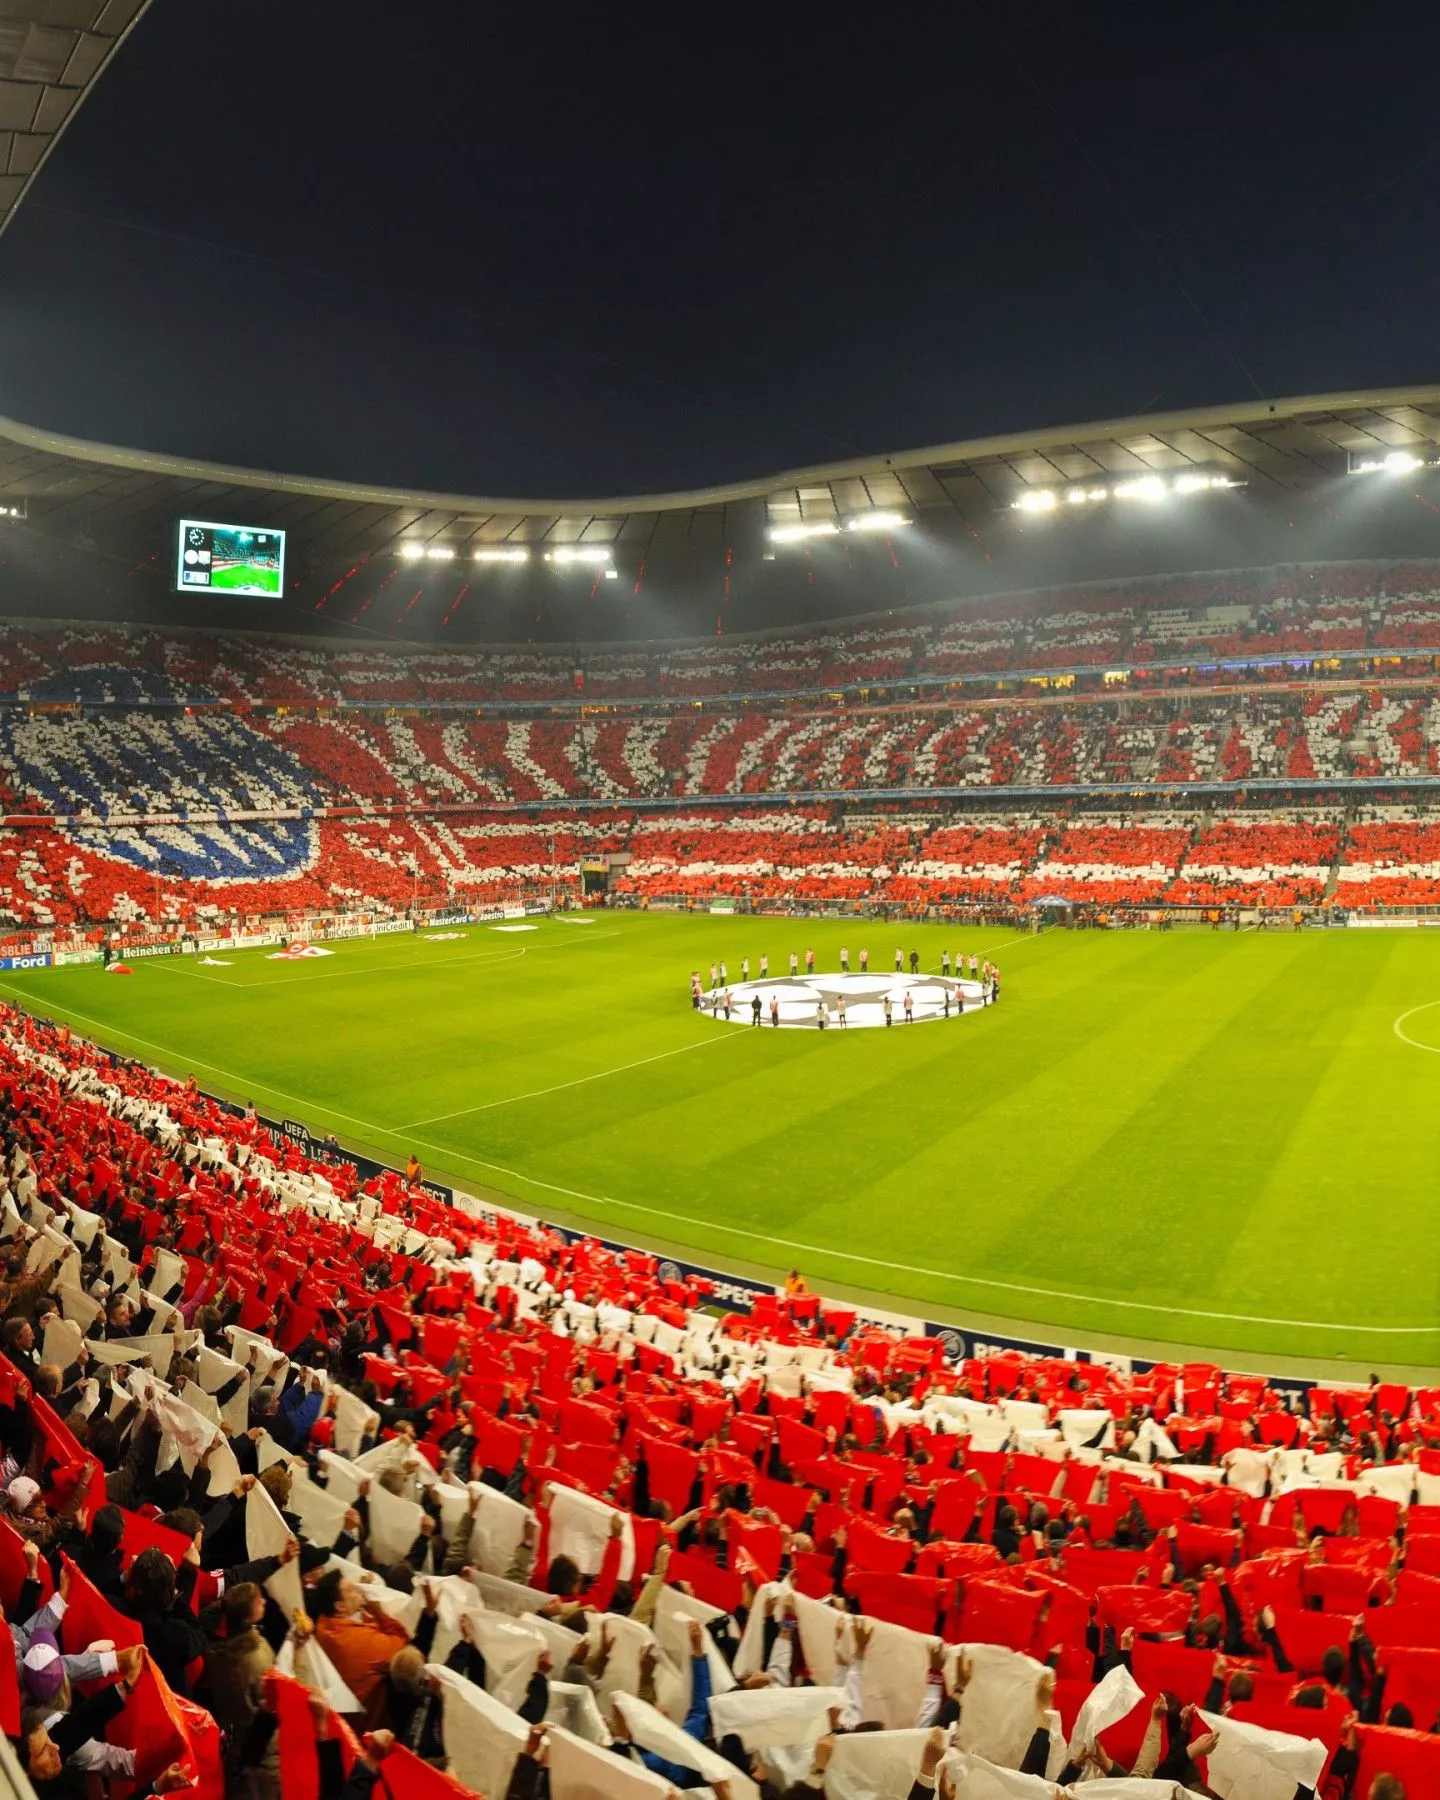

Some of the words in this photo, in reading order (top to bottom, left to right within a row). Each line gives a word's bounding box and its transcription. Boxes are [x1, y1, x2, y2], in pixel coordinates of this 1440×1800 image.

[374, 921, 408, 932] UniCredit
[429, 914, 467, 926] MasterCard
[131, 933, 168, 946] SHARKS
[203, 939, 235, 950] PS3
[123, 944, 171, 959] Heineken
[12, 955, 46, 969] Ford
[284, 1121, 308, 1141] UEFA
